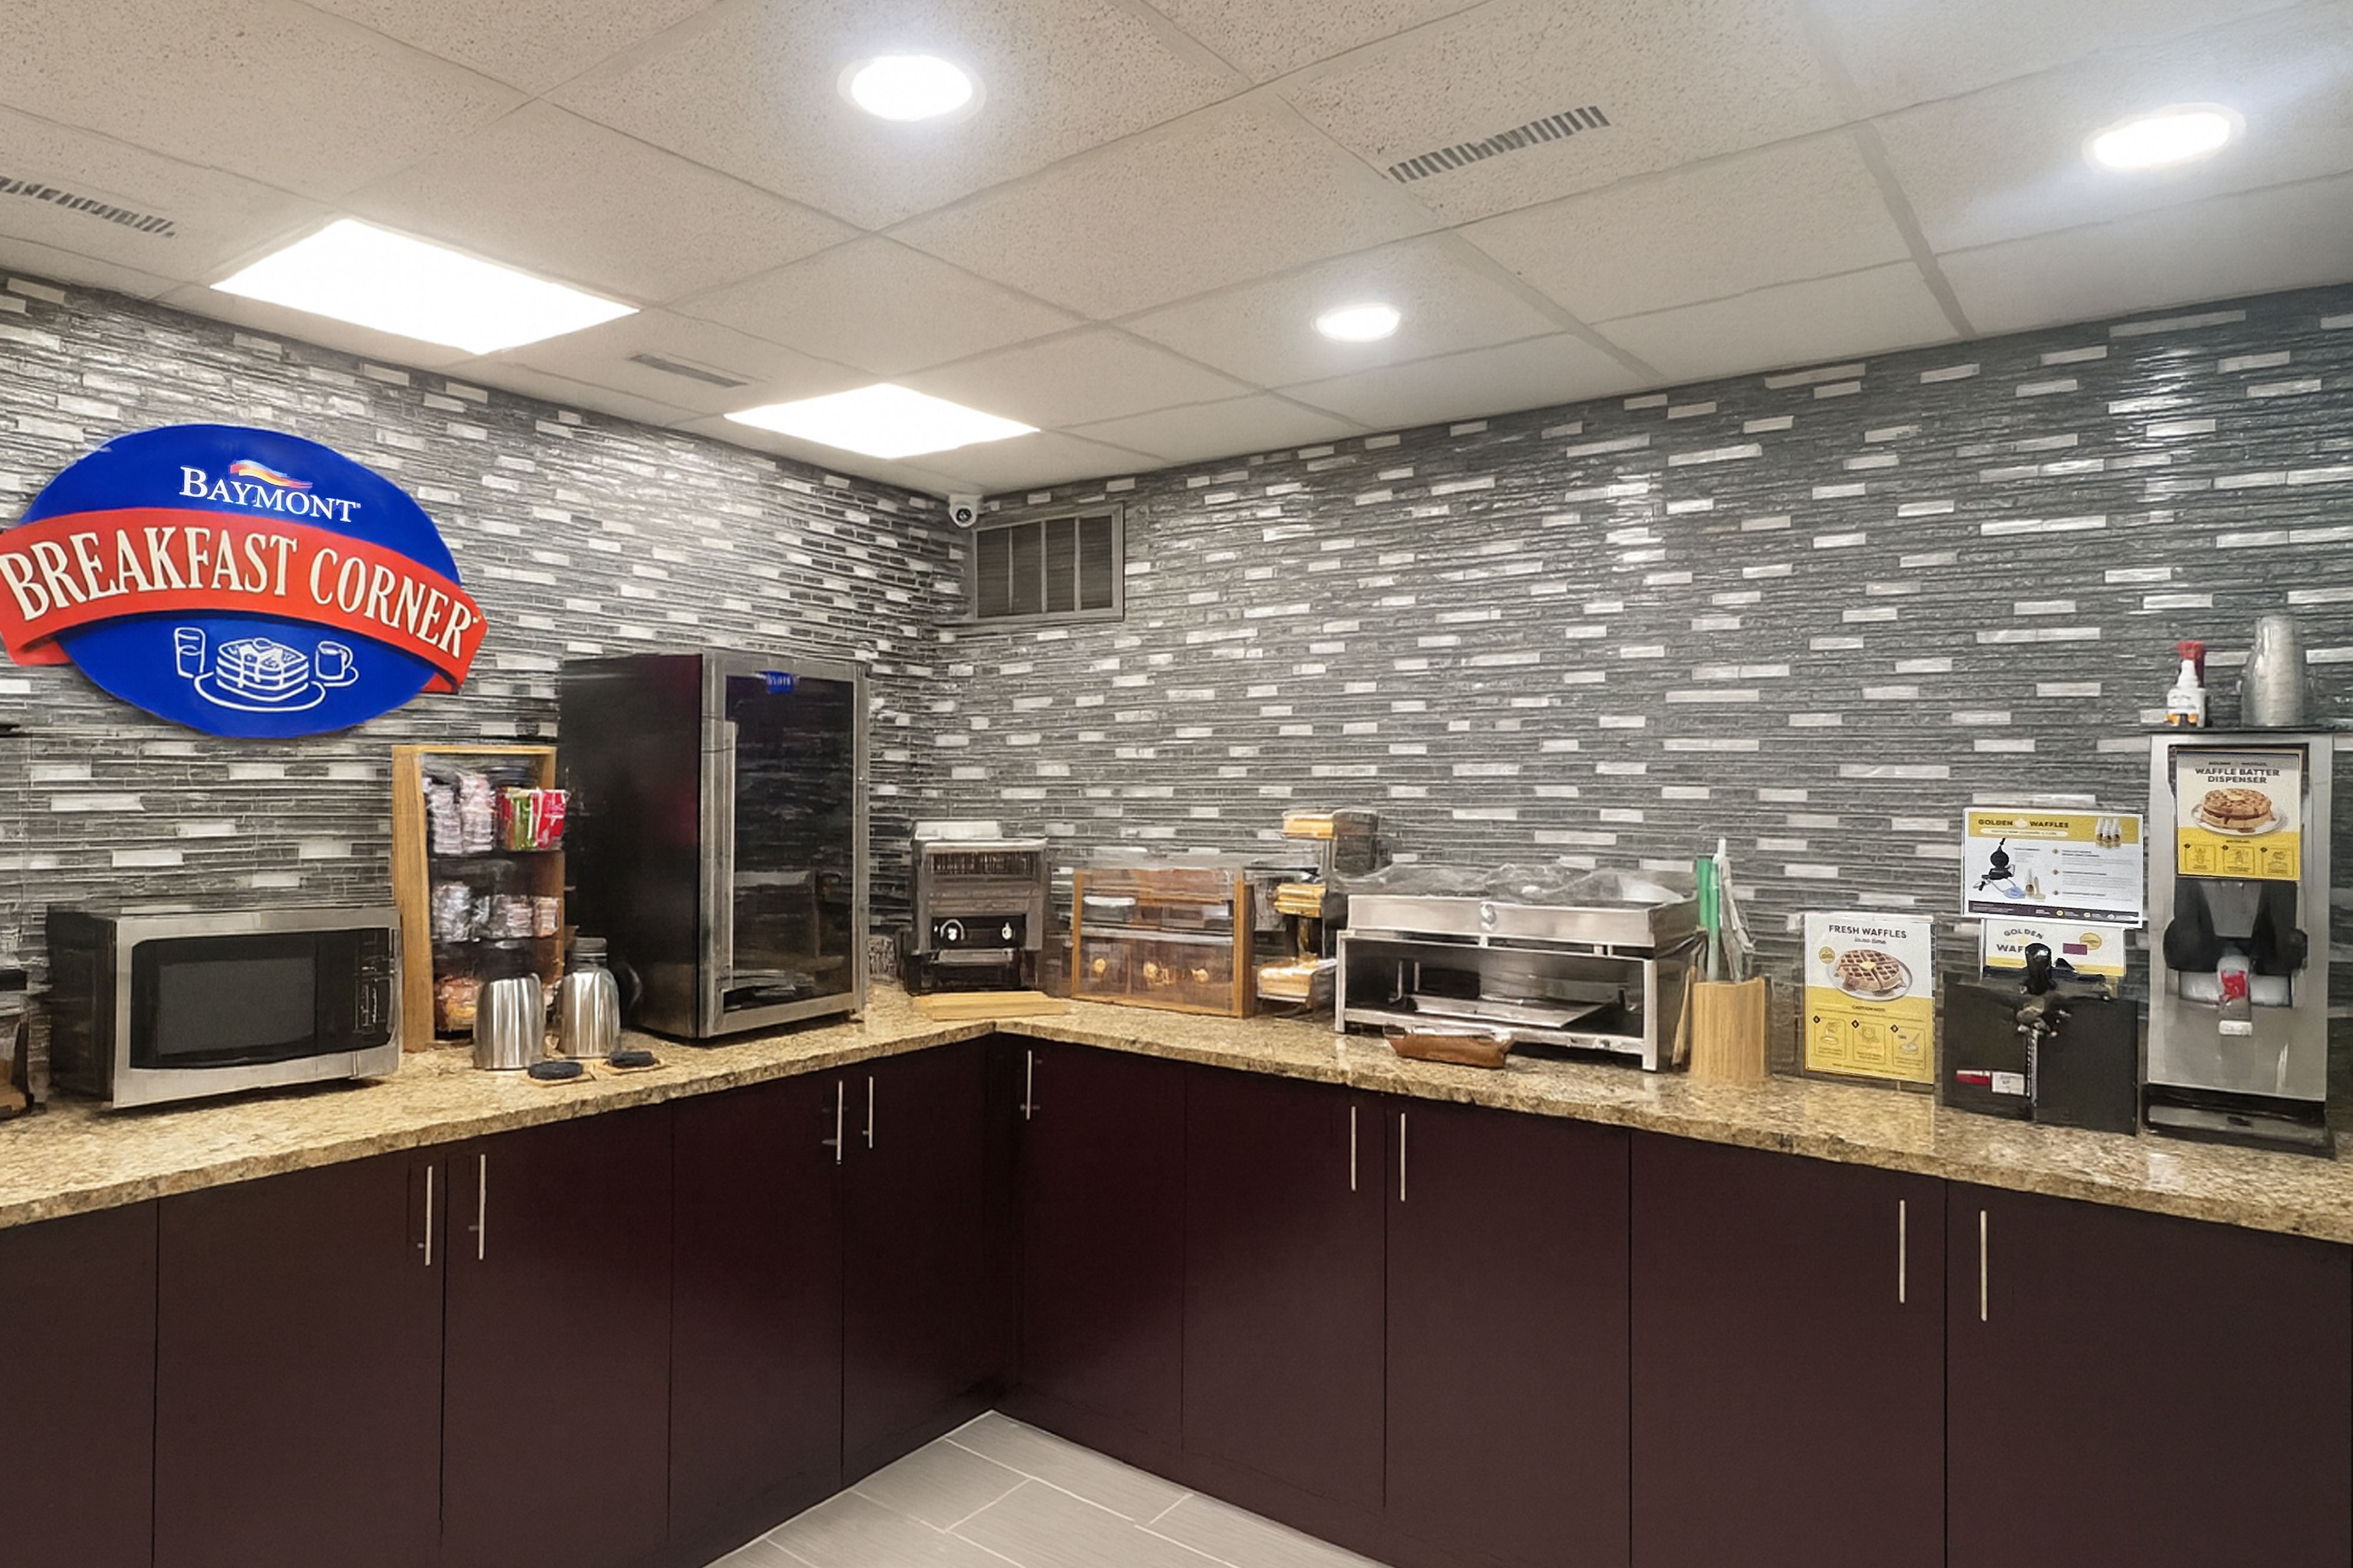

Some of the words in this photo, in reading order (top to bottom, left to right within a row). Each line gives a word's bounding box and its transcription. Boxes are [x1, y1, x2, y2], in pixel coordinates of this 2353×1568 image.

[179, 466, 356, 523] BAYMONT
[0, 526, 298, 622] BREAKFAST
[310, 548, 473, 659] CORNER
[2207, 775, 2267, 783] DISPENSER
[1829, 924, 1859, 935] FRESH
[1861, 928, 1907, 939] WAFFLES
[2004, 928, 2044, 939] GOLDEN
